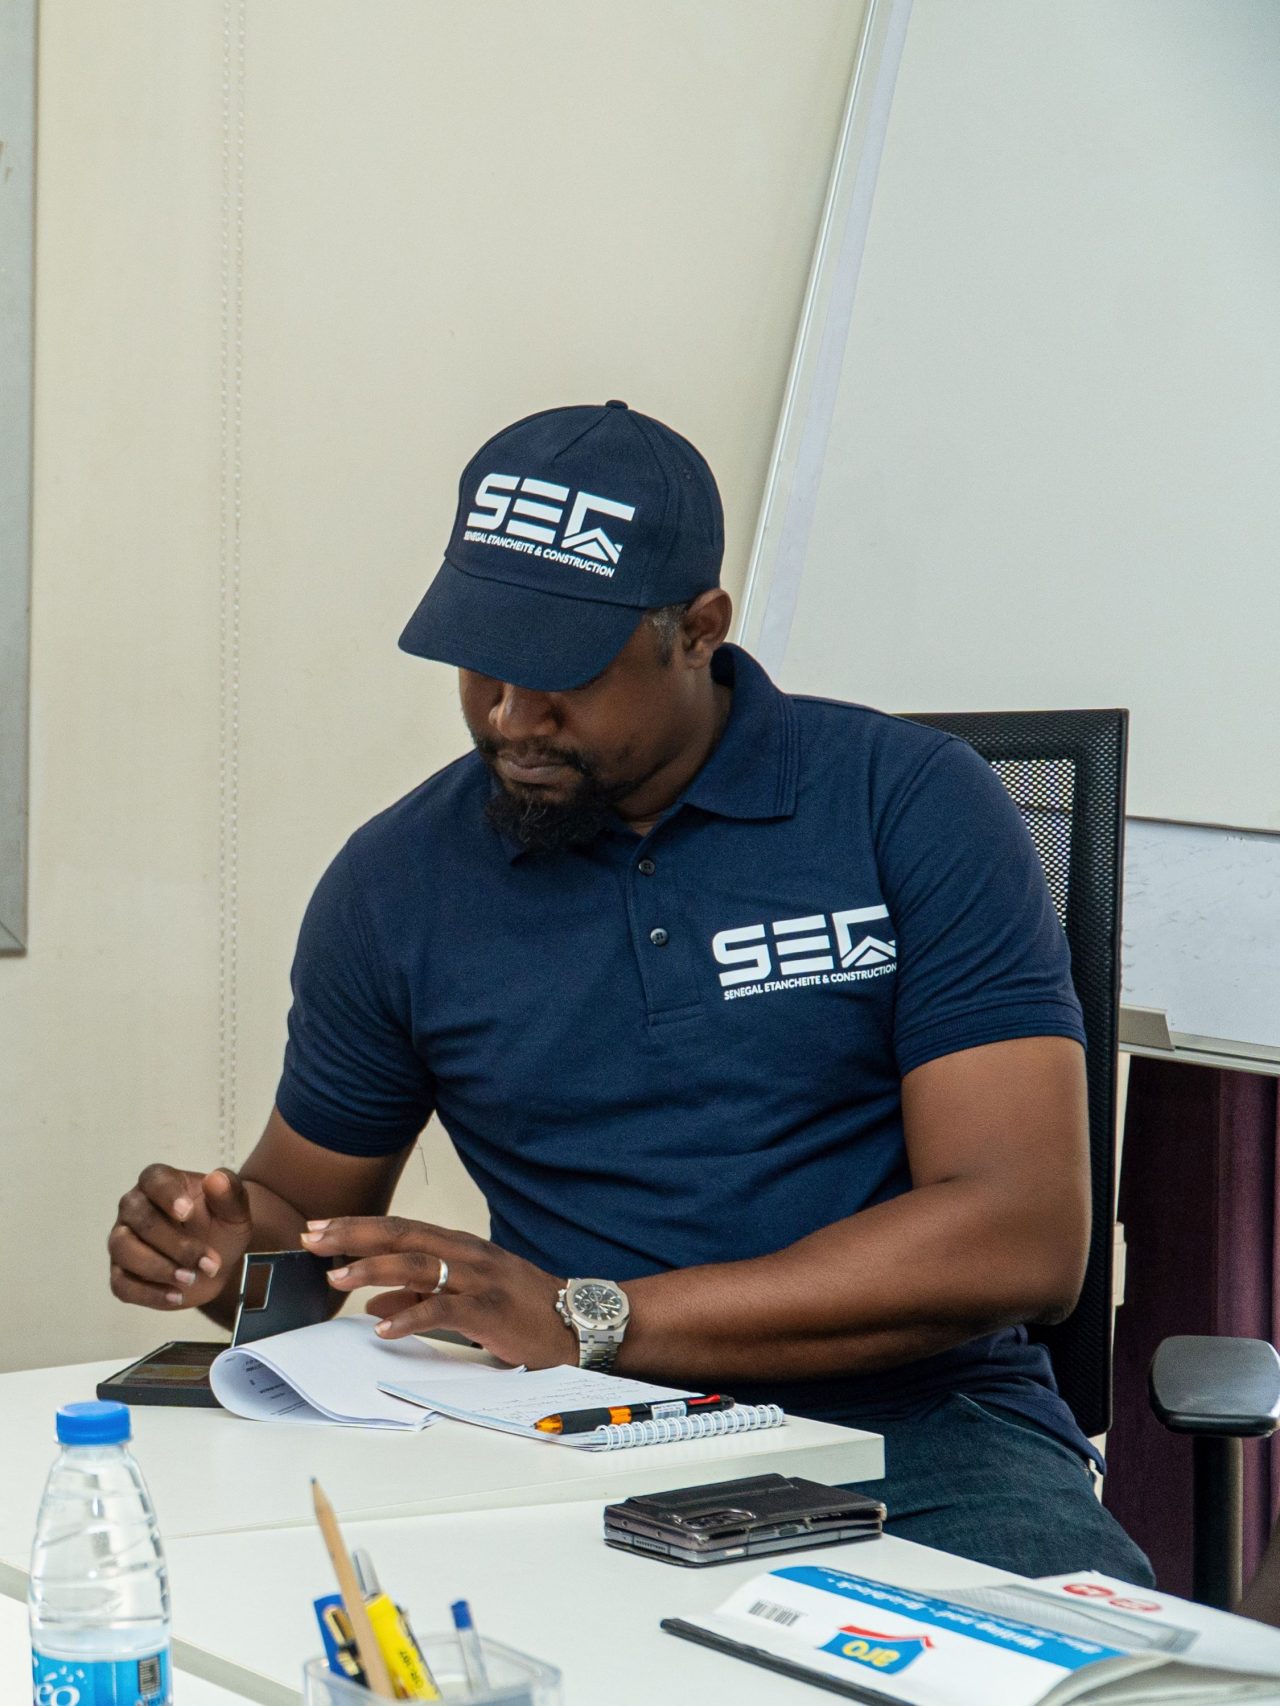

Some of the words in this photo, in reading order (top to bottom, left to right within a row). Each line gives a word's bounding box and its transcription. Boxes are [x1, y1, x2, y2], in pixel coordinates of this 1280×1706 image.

[463, 530, 487, 544] SENEGAL
[486, 535, 534, 554] ETANCHEITE
[534, 545, 542, 556] &
[542, 549, 616, 578] CONSTRUCTION
[724, 984, 764, 1000] SENEGAL
[764, 975, 821, 993] ETANCHEITE
[822, 974, 830, 984] &
[830, 962, 897, 983] CONSTRUCTION
[842, 1640, 900, 1667] aro
